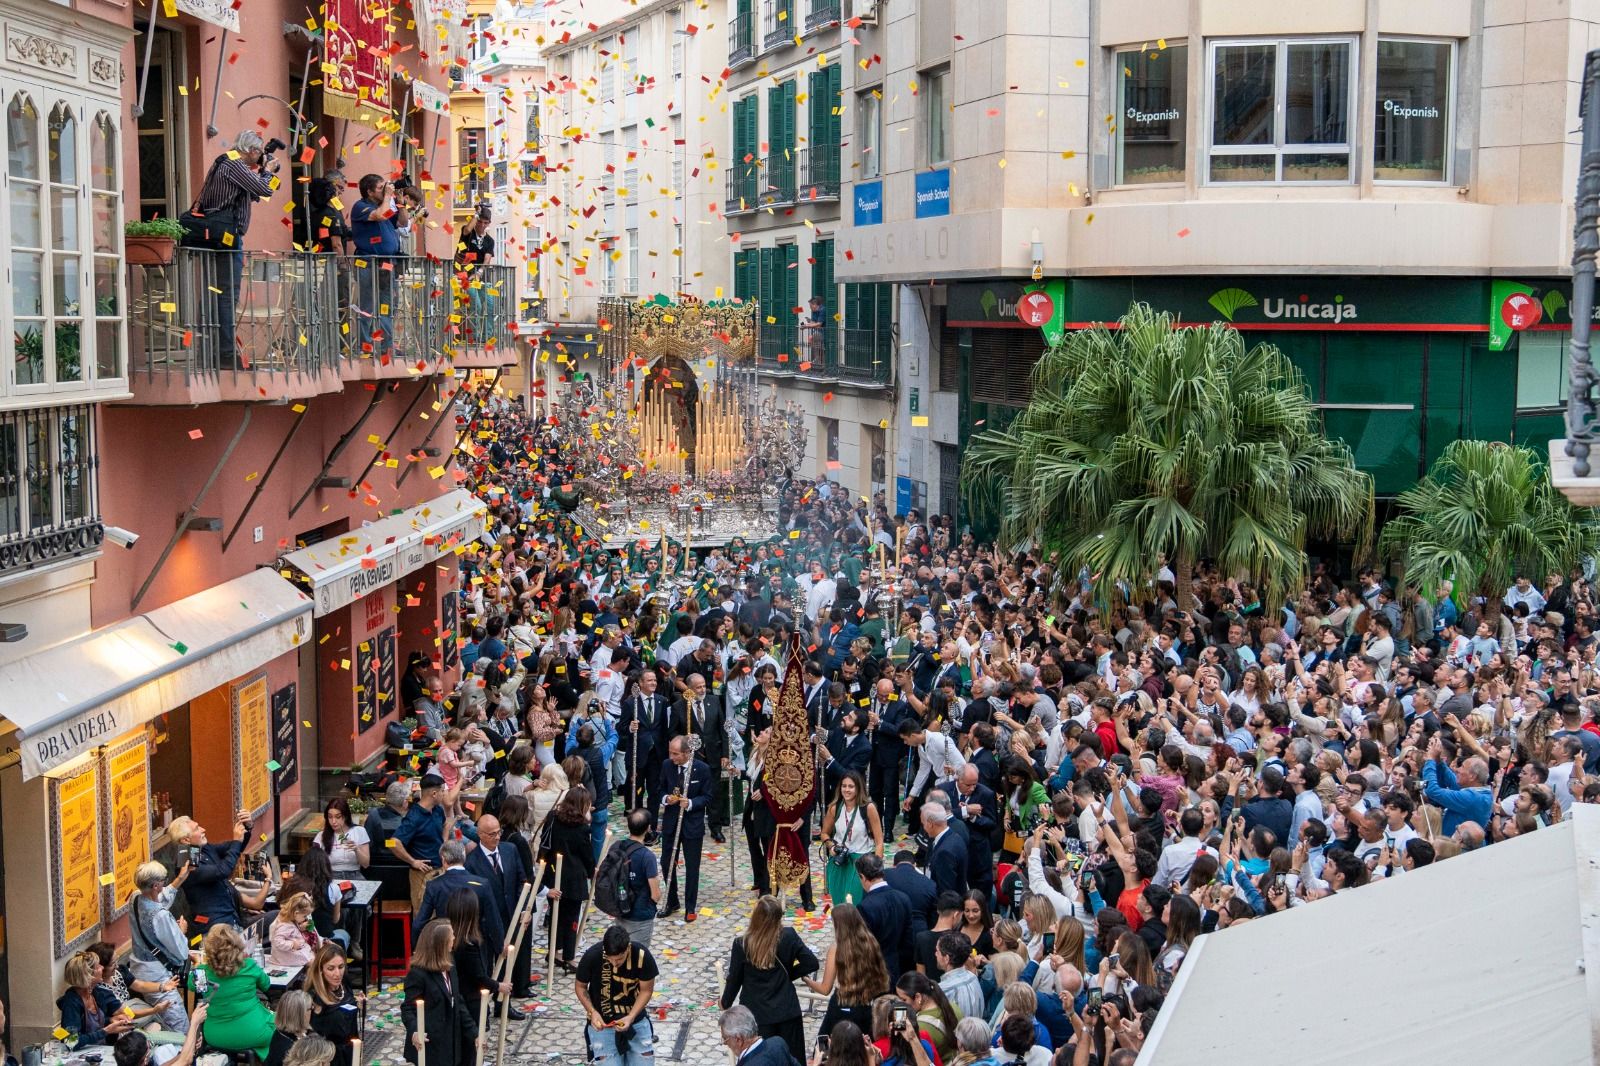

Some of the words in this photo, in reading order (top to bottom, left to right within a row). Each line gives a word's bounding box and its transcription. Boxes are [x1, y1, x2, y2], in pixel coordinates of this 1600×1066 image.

[1136, 108, 1179, 124] Expanish
[1394, 105, 1439, 119] Expanish
[916, 190, 934, 205] Spanish
[934, 187, 949, 201] School
[861, 200, 879, 213] Expanish
[1263, 294, 1357, 324] Unicaja
[350, 569, 367, 594] PEPA
